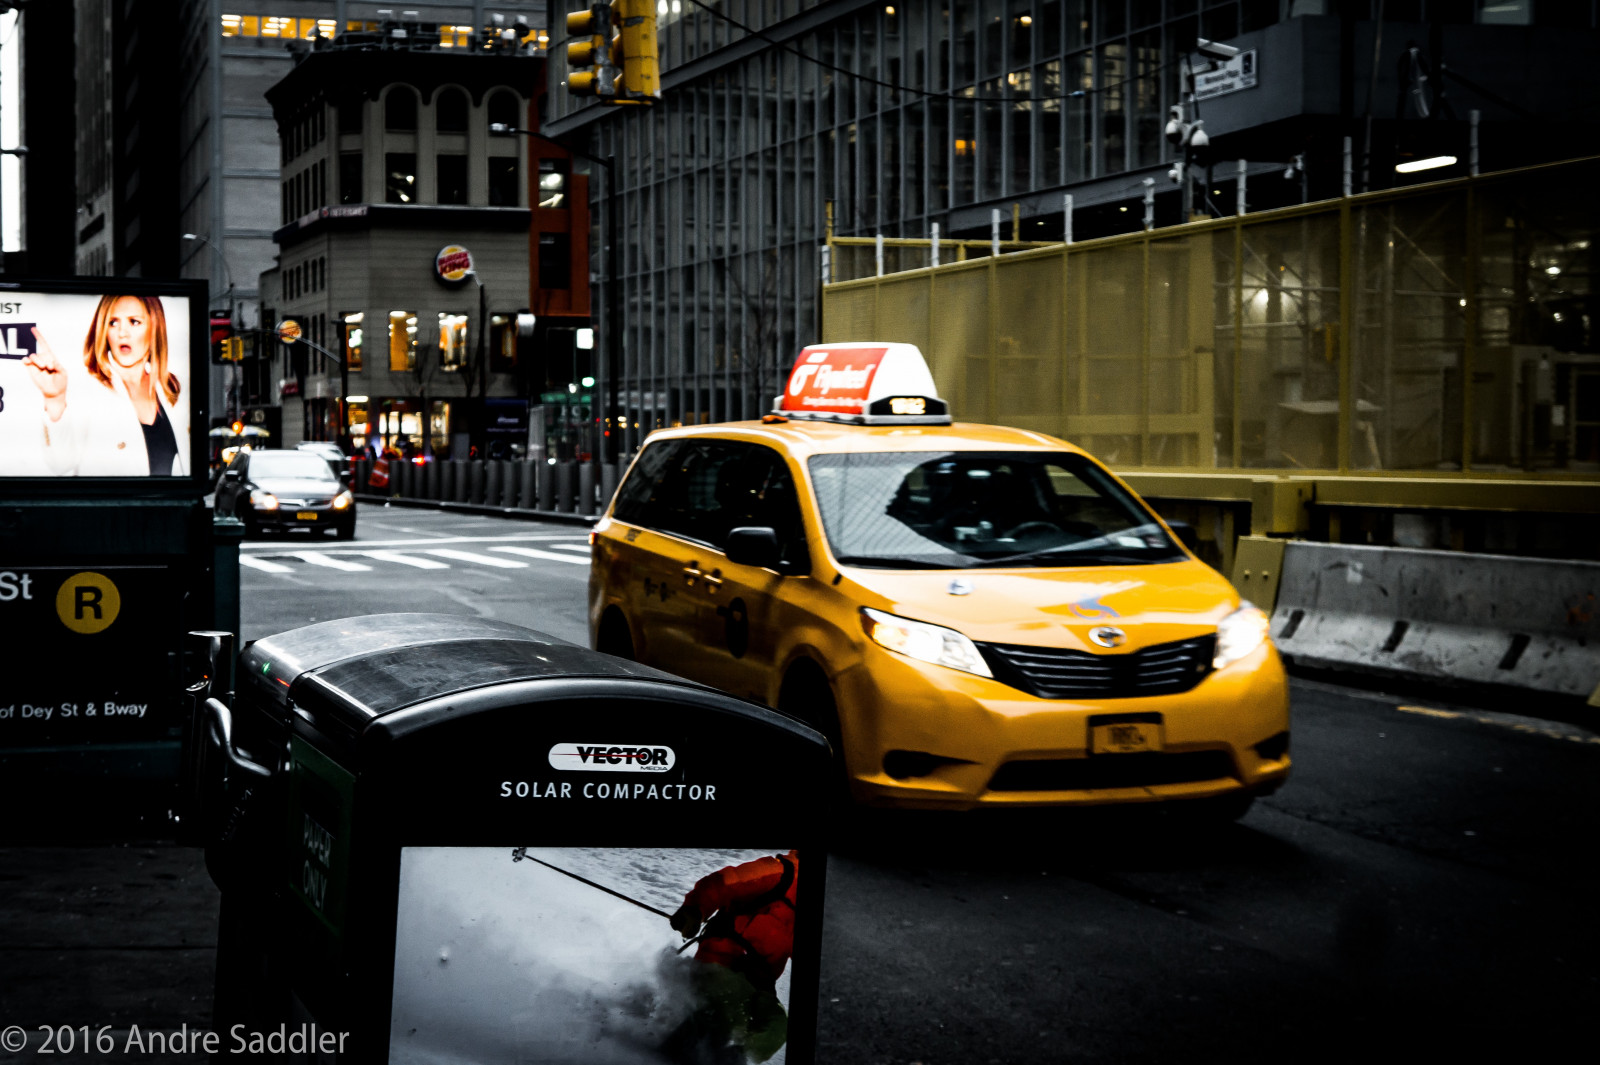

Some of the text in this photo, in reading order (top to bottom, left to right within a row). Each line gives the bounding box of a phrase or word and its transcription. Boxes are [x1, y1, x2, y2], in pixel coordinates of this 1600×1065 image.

[0, 571, 33, 602] St
[75, 586, 103, 620] R
[21, 703, 54, 721] Dey
[60, 702, 79, 717] St
[84, 702, 97, 716] &
[103, 701, 148, 718] Bway
[577, 746, 668, 766] VECTOR
[500, 781, 716, 800] SOLAR COMPACTOR
